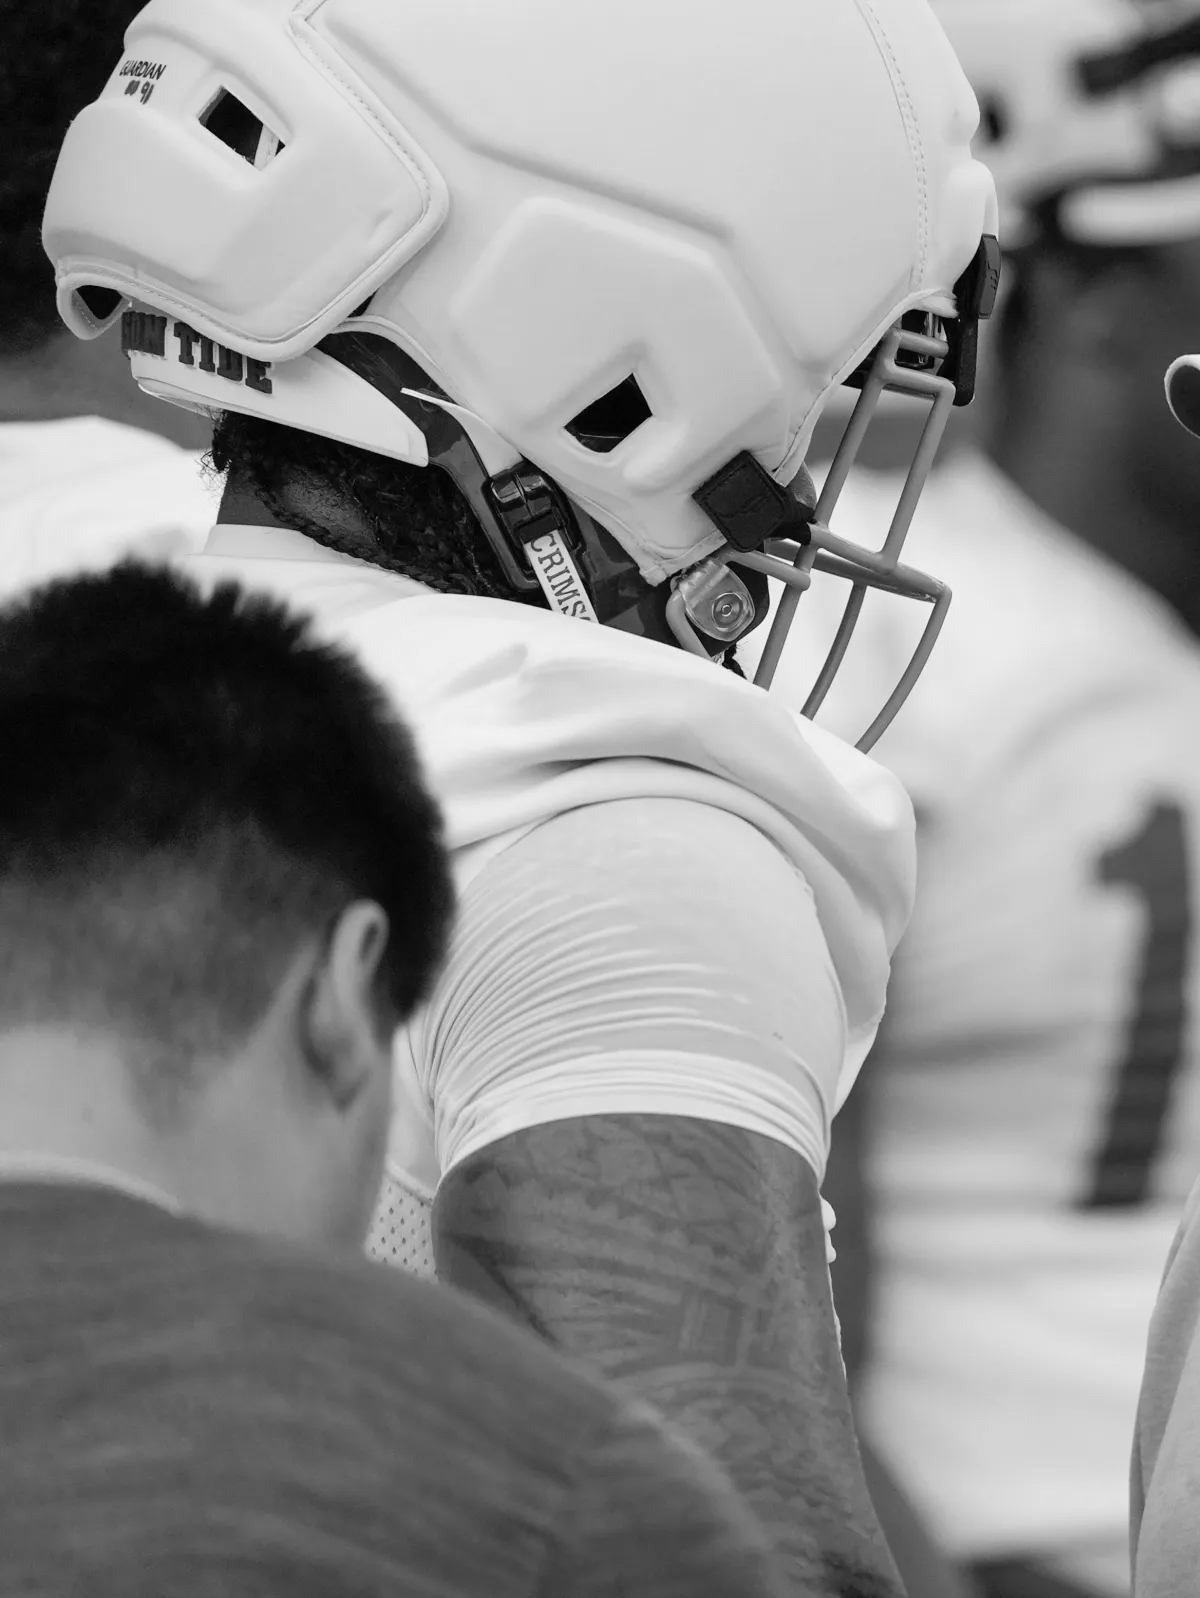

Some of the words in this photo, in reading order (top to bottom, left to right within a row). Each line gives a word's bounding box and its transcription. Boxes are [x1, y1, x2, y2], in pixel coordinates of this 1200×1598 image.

[119, 60, 167, 80] GUARDIAN
[174, 322, 273, 394] TIDE
[531, 532, 591, 623] CRIMS
